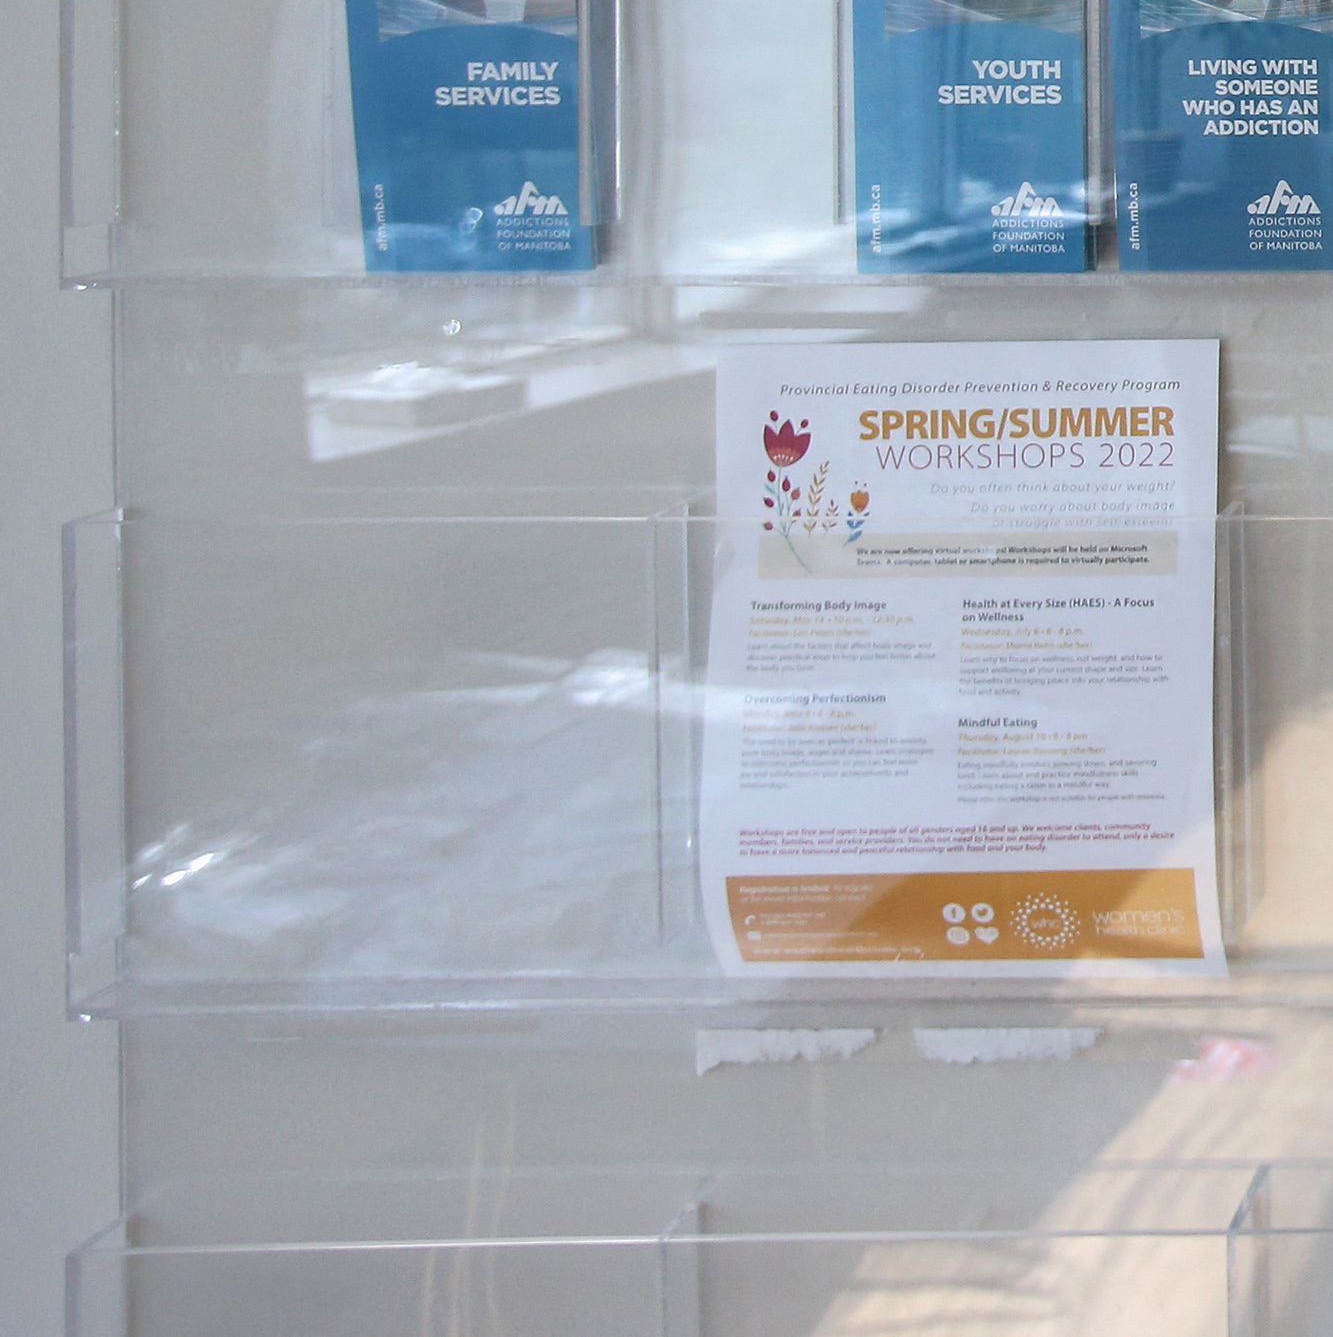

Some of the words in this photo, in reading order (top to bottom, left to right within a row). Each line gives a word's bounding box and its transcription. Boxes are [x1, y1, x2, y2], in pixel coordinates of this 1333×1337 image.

[467, 61, 559, 81] FAMILY
[972, 60, 1061, 80] YOUTH
[1188, 59, 1257, 75] LIVING
[1262, 59, 1318, 75] WITH
[938, 85, 1062, 105] SERVICES
[1215, 79, 1319, 95] SOMEONE
[435, 86, 561, 106] SERVICES
[1182, 100, 1235, 116] WHO
[1240, 100, 1283, 115] HAS
[1288, 99, 1318, 115] AN
[1203, 120, 1319, 136] ADDICTION
[871, 184, 881, 253] afm.mb.ca
[992, 219, 1064, 229] ADDICTIONS
[1129, 182, 1140, 250] afm.mb.ca
[1249, 217, 1321, 226] ADDICTIONS
[992, 232, 1065, 241] FOUNDATION
[1249, 229, 1322, 238] FOUNDATION
[993, 244, 1008, 253] OF
[1010, 244, 1066, 253] MANITOBA
[1249, 242, 1264, 251] OF
[1266, 242, 1323, 251] MANITOBA
[780, 383, 849, 395] Provincial
[853, 383, 897, 397] Eating
[901, 381, 960, 394] Disorder
[964, 380, 1038, 393] Prevention
[1042, 380, 1051, 391] &
[1056, 379, 1118, 394] Recovery
[1122, 378, 1180, 393] Program
[858, 406, 1175, 441] SPRING/SUMMER
[876, 442, 1085, 470] WORKSHOPS
[1099, 441, 1175, 469] 2022
[751, 601, 822, 612] Transforming
[824, 601, 851, 612] Body
[963, 598, 998, 609] Health
[1000, 599, 1011, 609] at
[1013, 598, 1043, 610] Every
[1045, 598, 1067, 608] Size
[1069, 597, 1106, 609] (HAES)
[1114, 598, 1122, 607] A
[1124, 597, 1155, 608] Focus
[962, 614, 976, 622] on
[978, 611, 1025, 622] Wellness
[958, 717, 1001, 728] Mindful
[1003, 717, 1038, 729] Eating
